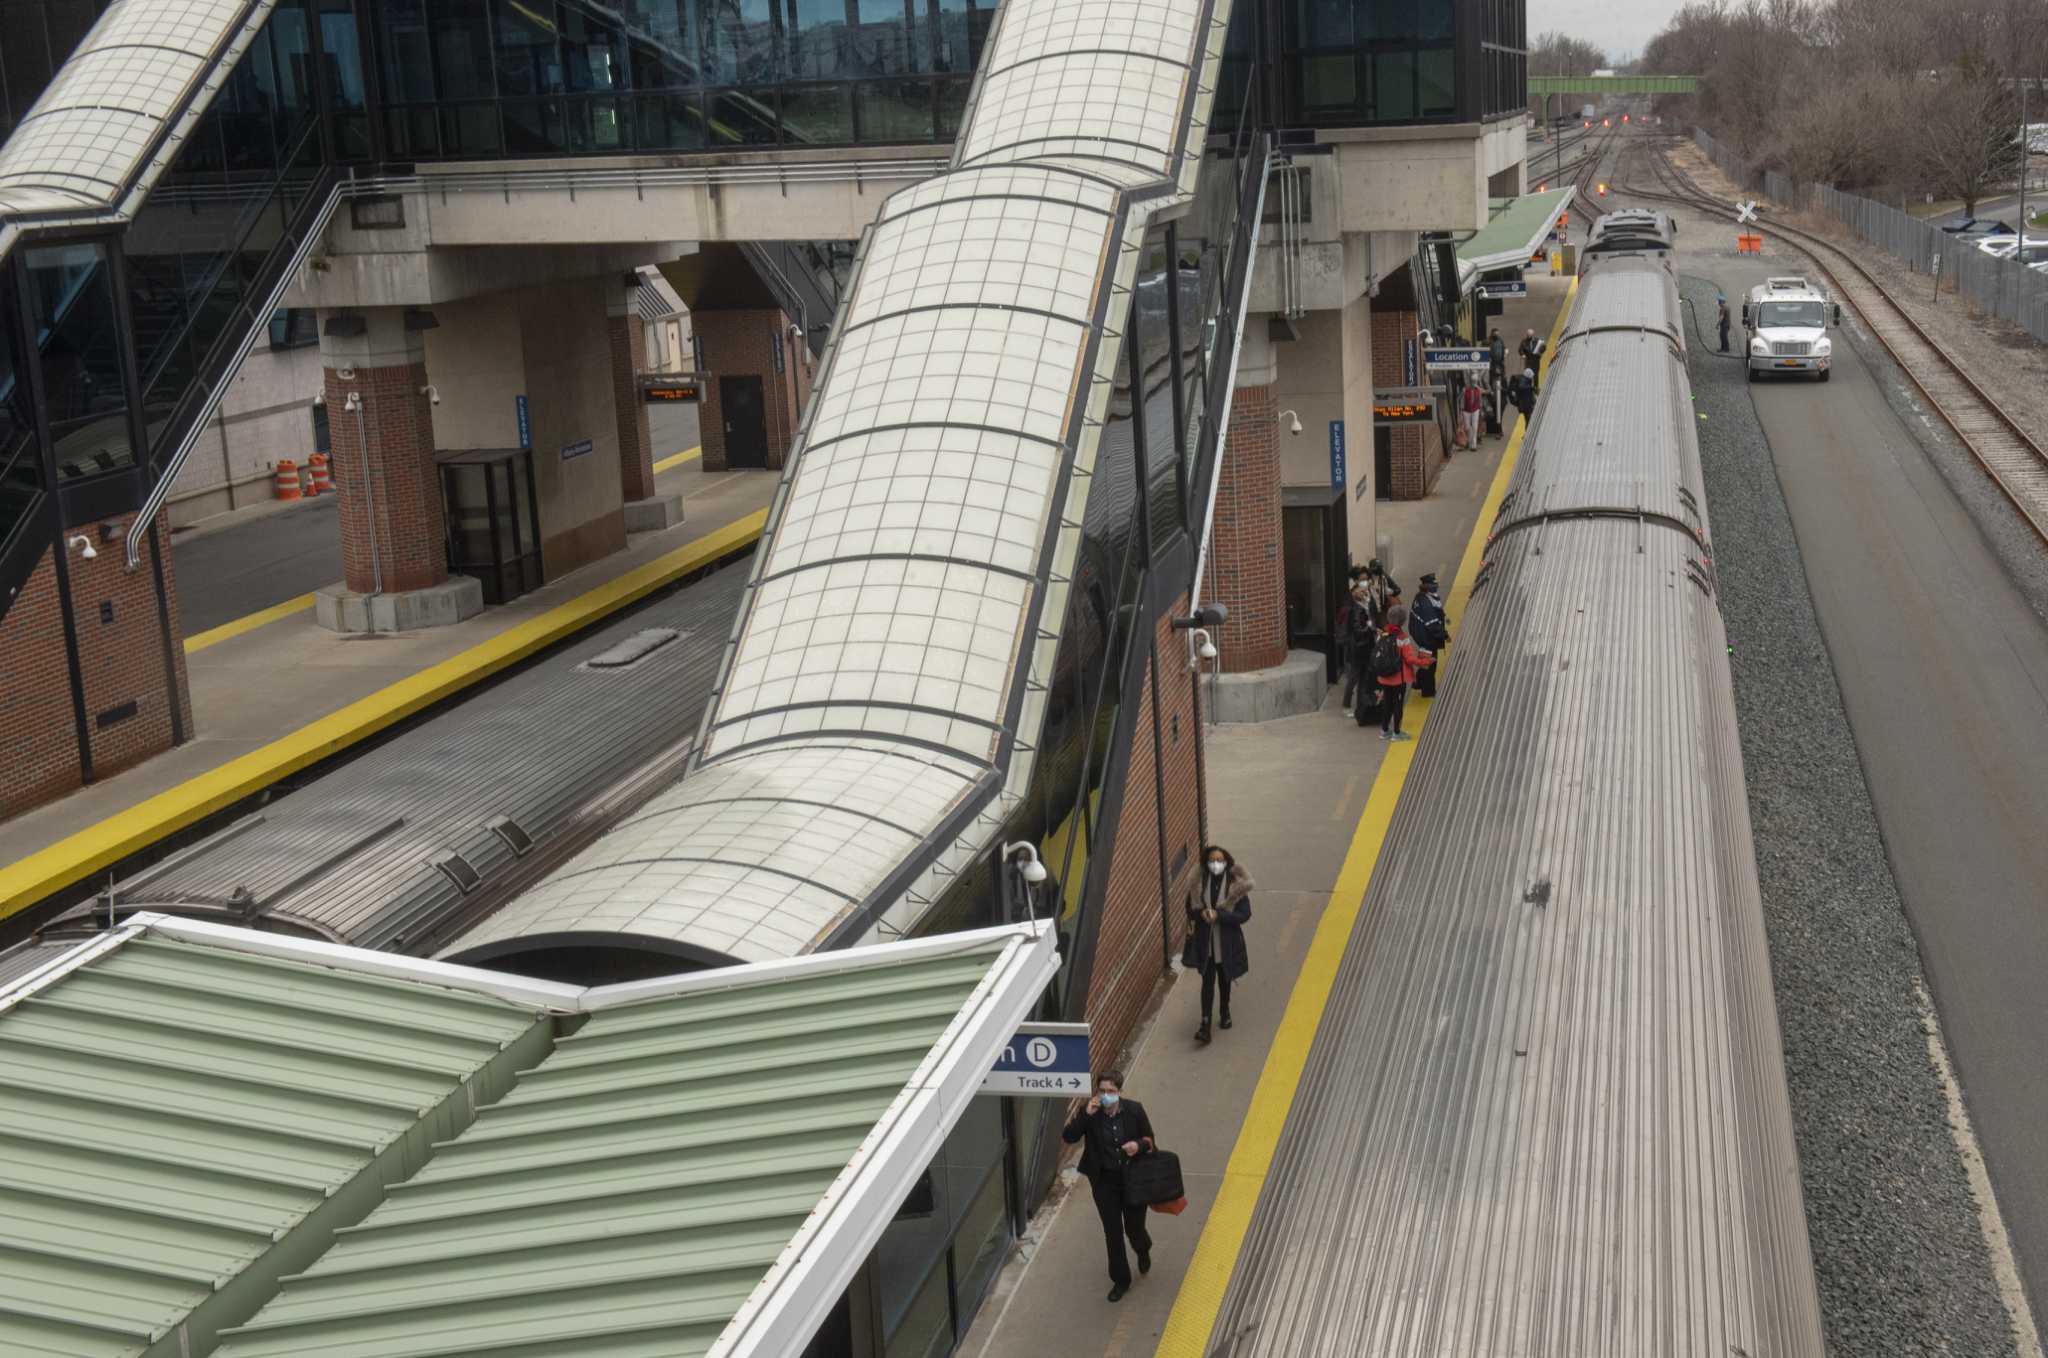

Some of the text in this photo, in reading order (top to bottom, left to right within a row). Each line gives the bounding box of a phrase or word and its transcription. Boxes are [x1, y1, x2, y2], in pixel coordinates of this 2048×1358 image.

[1434, 352, 1469, 361] Location
[1334, 423, 1342, 482] ELEVATOR
[1034, 1042, 1051, 1062] D
[1018, 1076, 1064, 1089] Track 4
